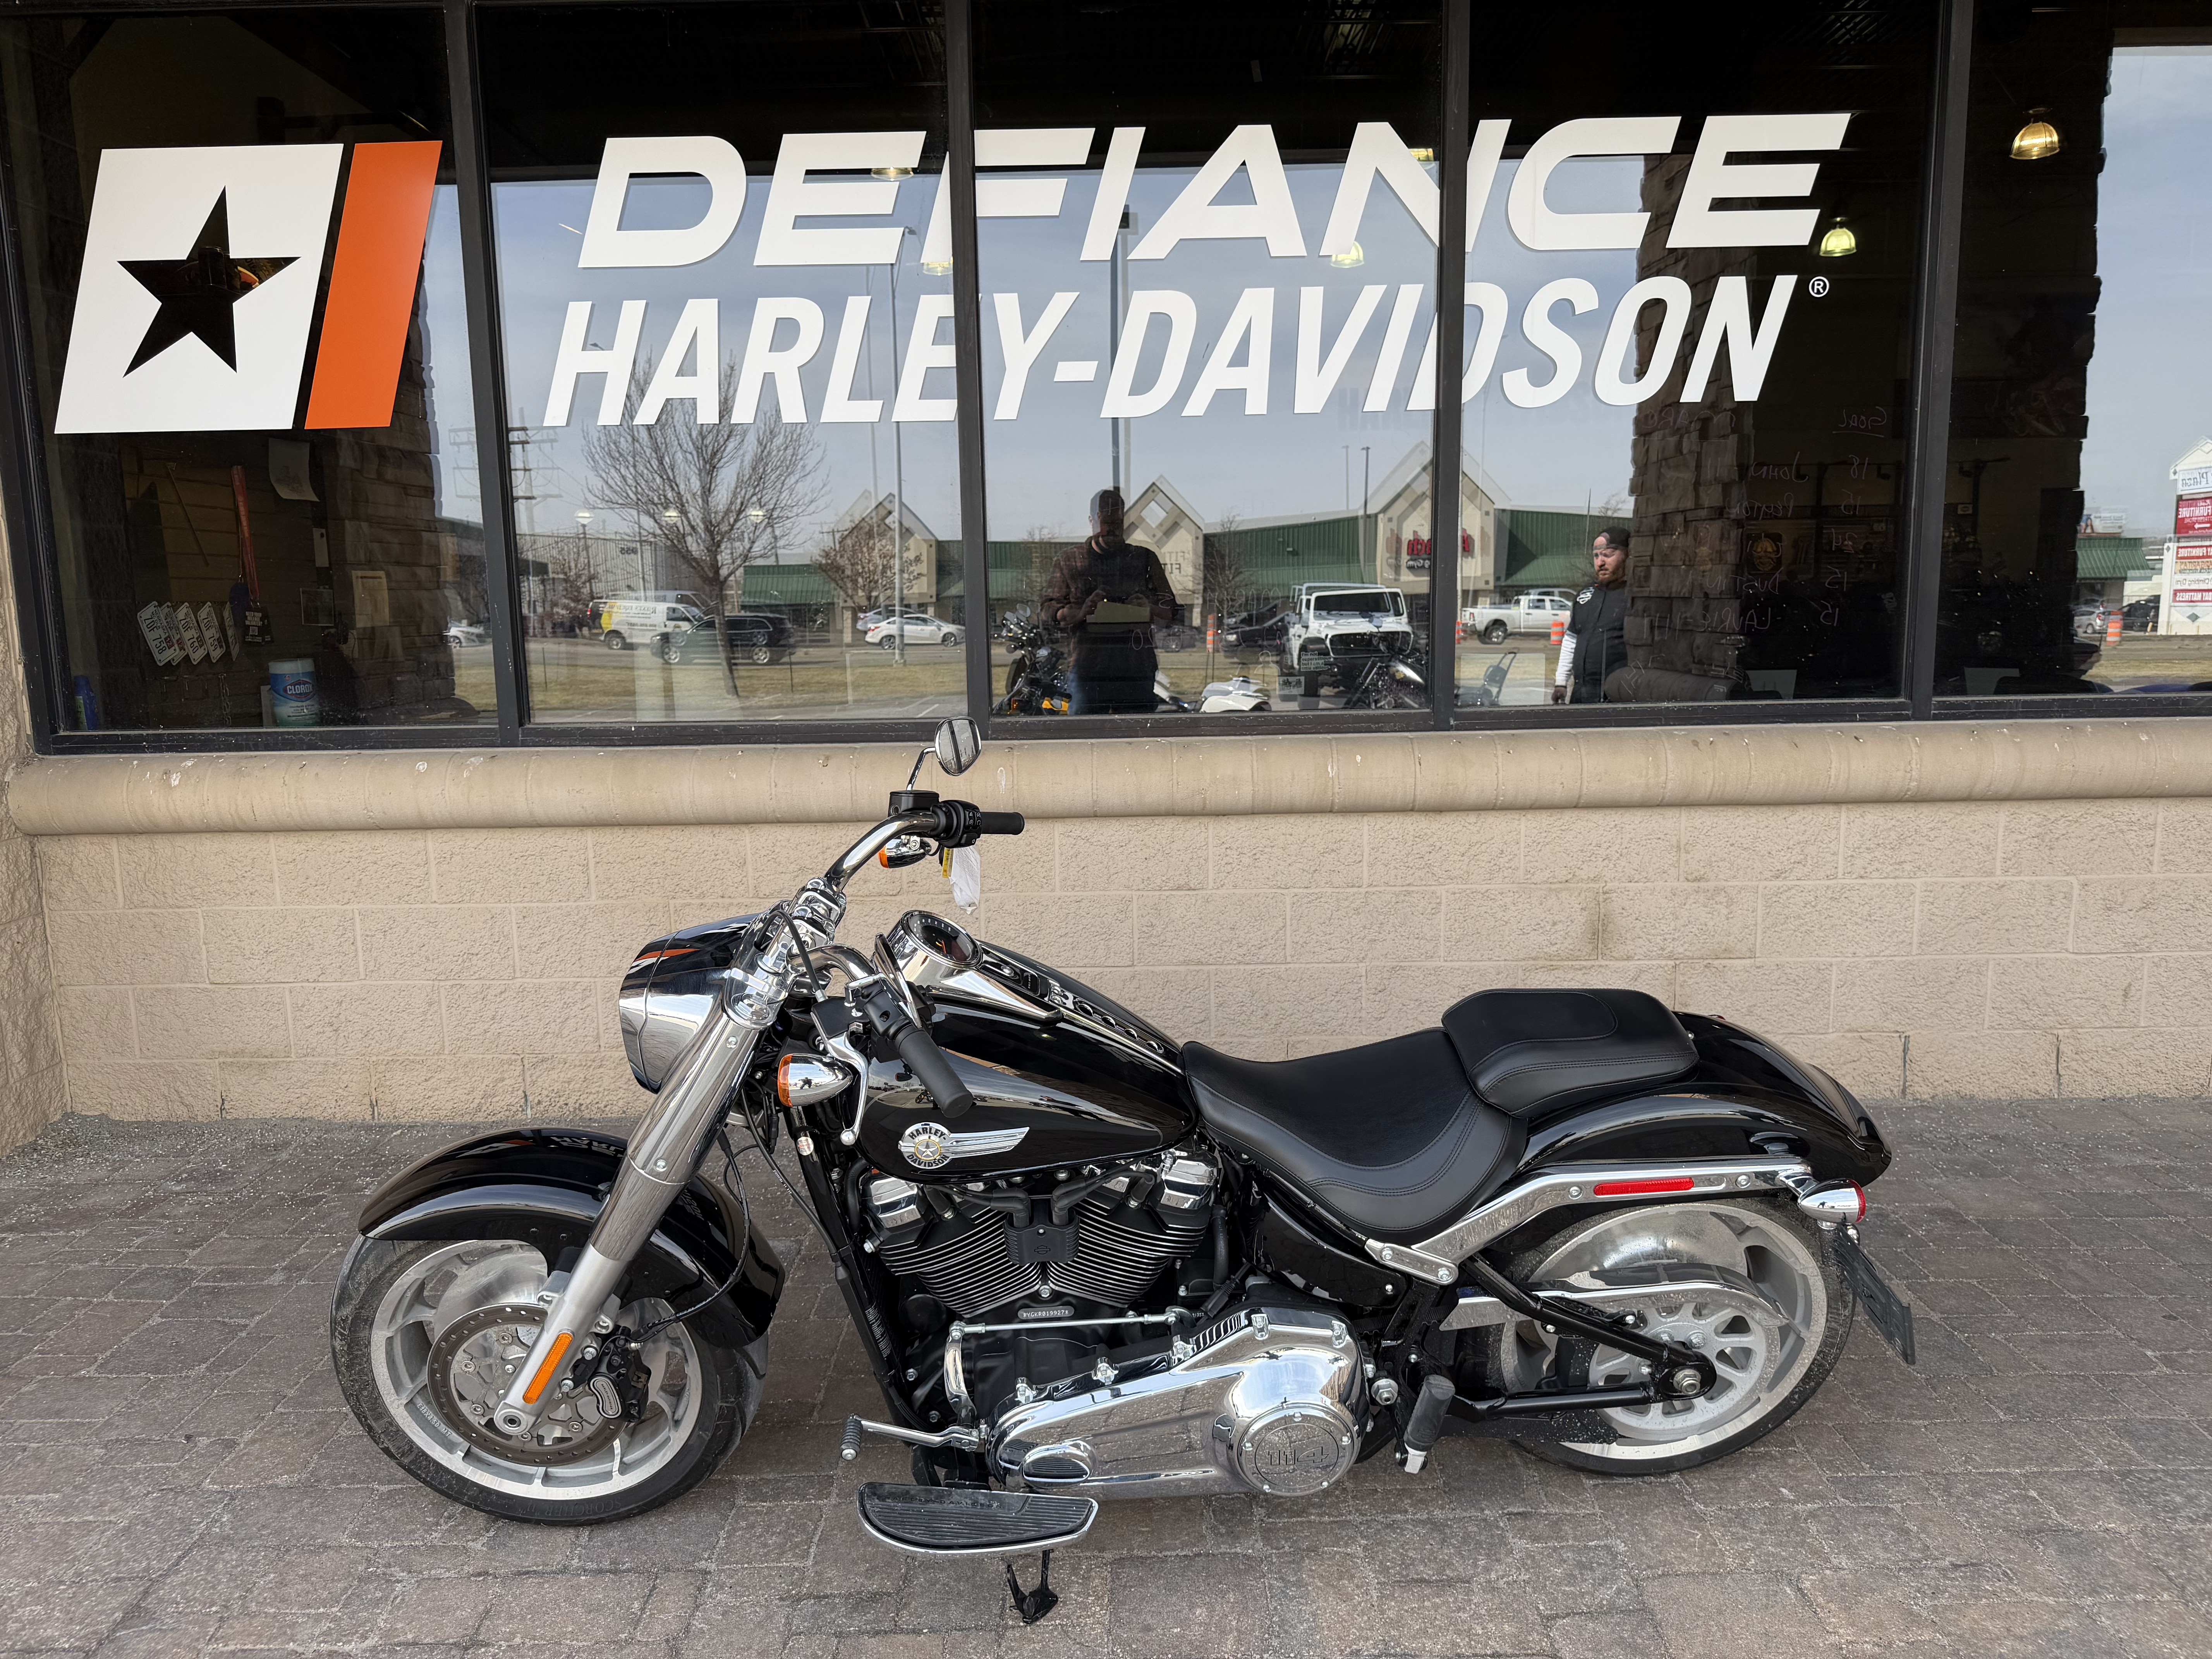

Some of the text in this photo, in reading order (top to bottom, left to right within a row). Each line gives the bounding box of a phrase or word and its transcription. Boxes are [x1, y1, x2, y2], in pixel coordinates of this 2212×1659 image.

[578, 113, 1851, 268] DEFIANCE
[179, 615, 192, 633] ZDF
[152, 634, 167, 655] 758
[187, 634, 199, 654] 760
[208, 633, 218, 653] 759
[287, 684, 313, 694] CLOROX
[908, 1127, 947, 1140] HARLEY-
[906, 1153, 950, 1168] DAVIDSON
[1268, 1446, 1329, 1466] 114
[544, 1497, 622, 1516] SCORCHER
